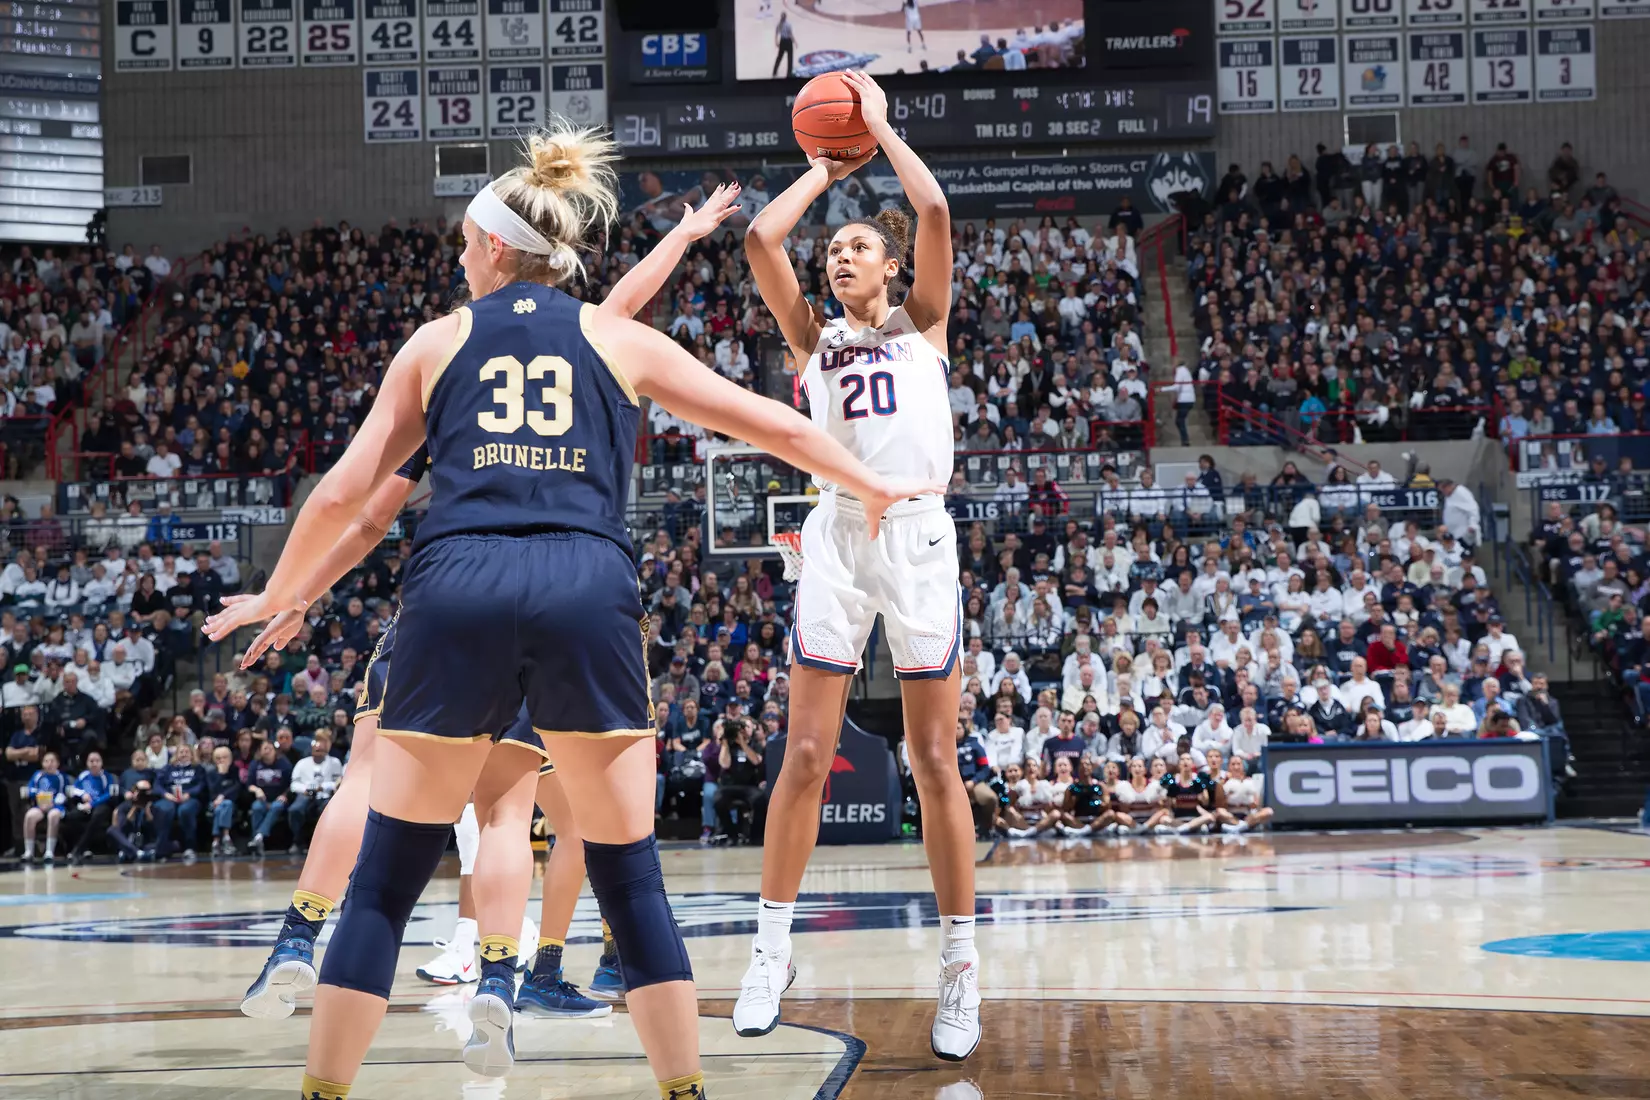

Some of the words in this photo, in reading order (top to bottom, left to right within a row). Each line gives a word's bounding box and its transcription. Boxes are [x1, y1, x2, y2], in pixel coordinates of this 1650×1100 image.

[131, 29, 156, 56] C
[198, 28, 213, 54] 9
[247, 26, 288, 53] 22
[308, 24, 350, 51] 25
[371, 21, 413, 49] 42
[432, 19, 474, 46] 44
[556, 15, 598, 43] 42
[641, 33, 701, 55] CBS
[1105, 35, 1177, 51] TRAVELERS
[1236, 70, 1257, 97] 15
[1298, 67, 1322, 95] 22
[1423, 62, 1450, 91] 42
[1488, 59, 1514, 88] 13
[1559, 57, 1571, 85] 3
[894, 93, 946, 120] 6:40
[1013, 87, 1039, 99] POSS
[371, 100, 414, 127] 24
[438, 97, 471, 125] 13
[497, 96, 535, 123] 22
[1187, 95, 1212, 124] 19
[738, 134, 753, 146] 30
[755, 132, 779, 146] SEC
[975, 124, 993, 138] TM
[996, 124, 1017, 138] FLS
[1048, 122, 1063, 136] 30
[1066, 121, 1089, 135] SEC
[1118, 119, 1146, 133] FULL
[682, 134, 709, 148] FULL
[983, 165, 1029, 178] Gampel
[1031, 163, 1078, 175] Pavilion
[1089, 161, 1128, 174] Storrs,
[1130, 161, 1147, 172] CT
[132, 189, 160, 203] 213
[948, 181, 1010, 194] Basketball
[1012, 179, 1056, 193] Capital
[1057, 180, 1070, 190] of
[1072, 179, 1093, 190] the
[1094, 177, 1133, 189] World
[820, 341, 914, 372] UCONN
[477, 355, 573, 436] 33
[840, 371, 897, 421] 20
[473, 443, 587, 473] BRUNELLE
[1371, 494, 1396, 506] SEC
[1405, 491, 1439, 507] 116
[1542, 488, 1567, 499] SEC
[1577, 485, 1611, 501] 117
[966, 502, 999, 519] 116
[172, 528, 195, 539] SEC
[206, 524, 237, 541] 113
[1273, 754, 1540, 807] GEICO
[821, 803, 886, 824] ELERS
